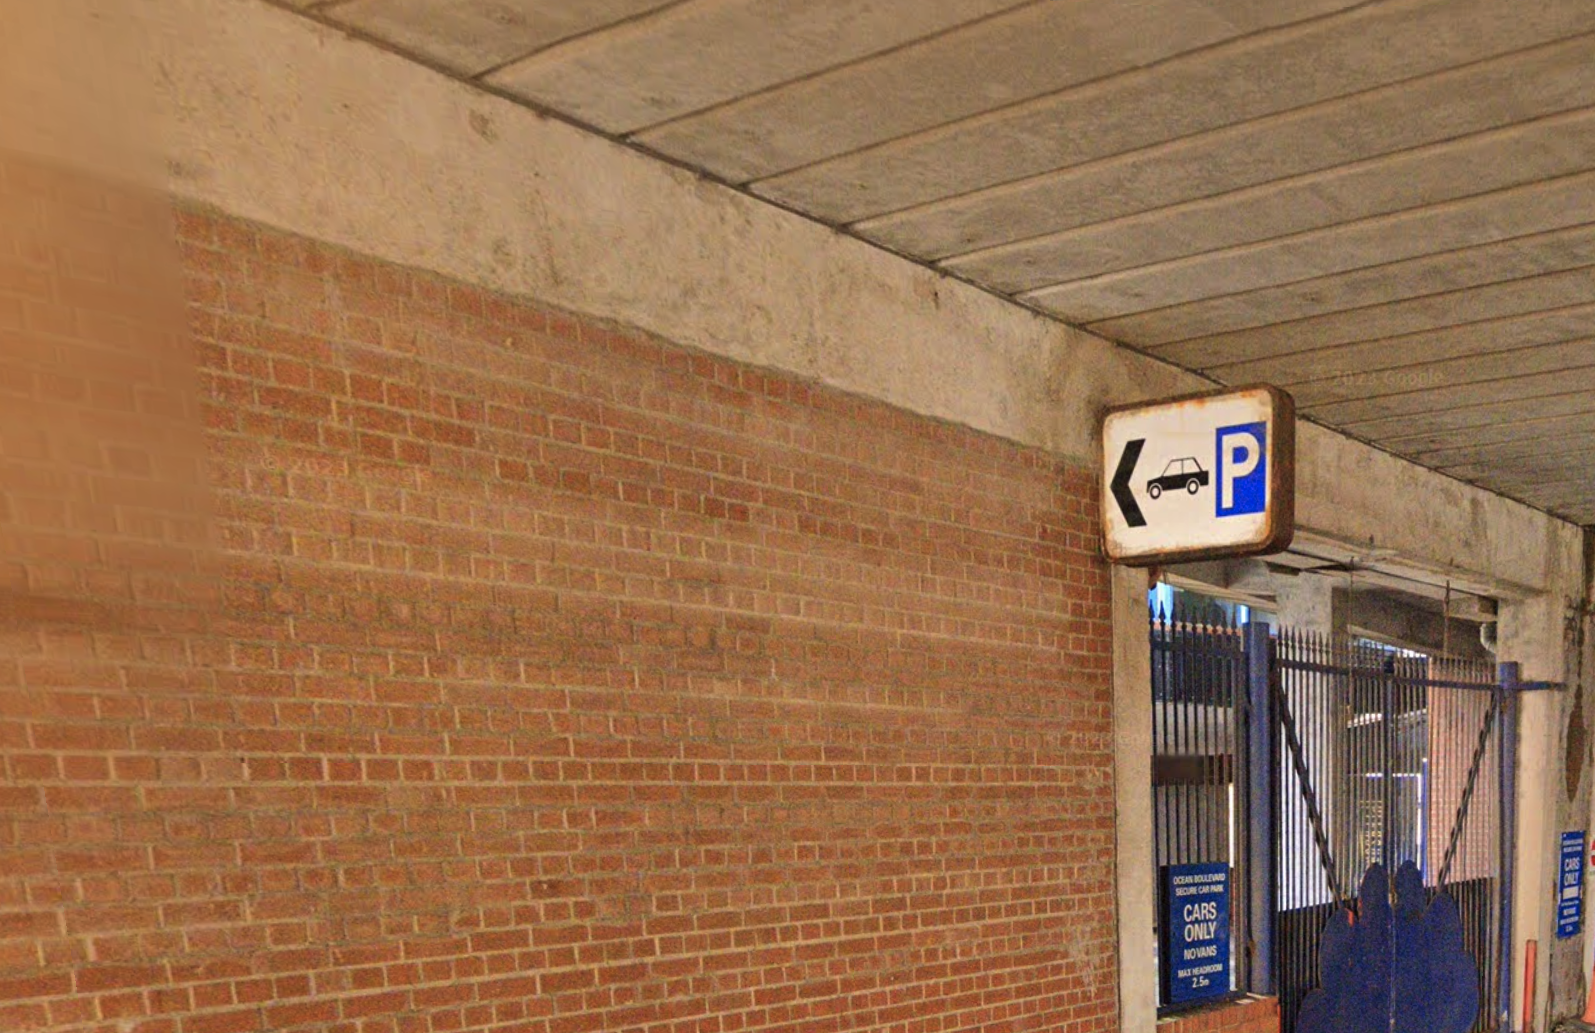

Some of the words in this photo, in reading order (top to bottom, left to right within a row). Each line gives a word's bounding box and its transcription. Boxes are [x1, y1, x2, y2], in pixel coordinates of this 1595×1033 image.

[1221, 431, 1260, 509] P
[1198, 885, 1210, 894] CAR
[1183, 902, 1217, 922] CARS
[1184, 922, 1217, 942] ONLY
[1183, 948, 1196, 960] NO
[1196, 945, 1217, 958] VANS
